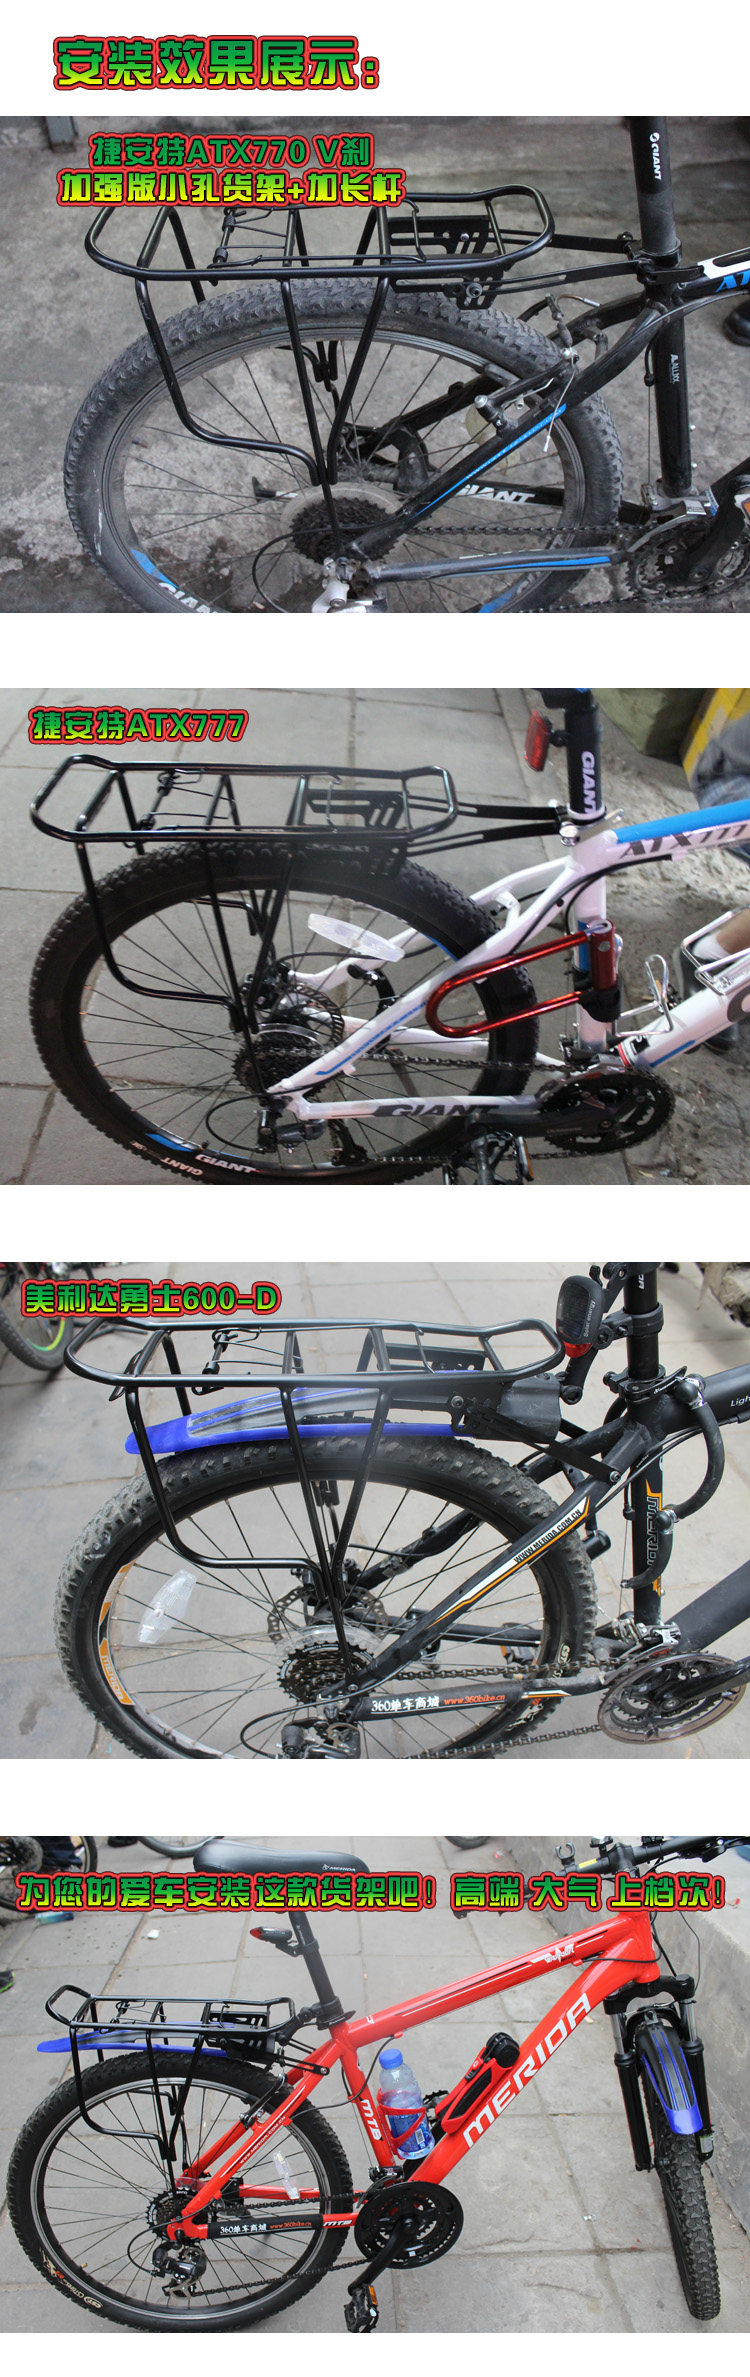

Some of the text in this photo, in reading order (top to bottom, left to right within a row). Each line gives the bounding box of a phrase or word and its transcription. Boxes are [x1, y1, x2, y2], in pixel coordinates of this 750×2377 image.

[651, 141, 662, 181] GIANT
[581, 750, 597, 815] GIANT
[160, 1156, 204, 1176] GIANT
[195, 1152, 258, 1174] GIANT
[513, 1508, 582, 1565] WWW.MERIDA.COM.CN
[646, 1496, 659, 1566] MERID
[370, 1694, 507, 1713] 360单车商城 www.360bike.cn
[462, 1993, 592, 2148] MERIDA
[361, 2099, 381, 2140] MTB
[219, 2223, 267, 2234] 360单车商城
